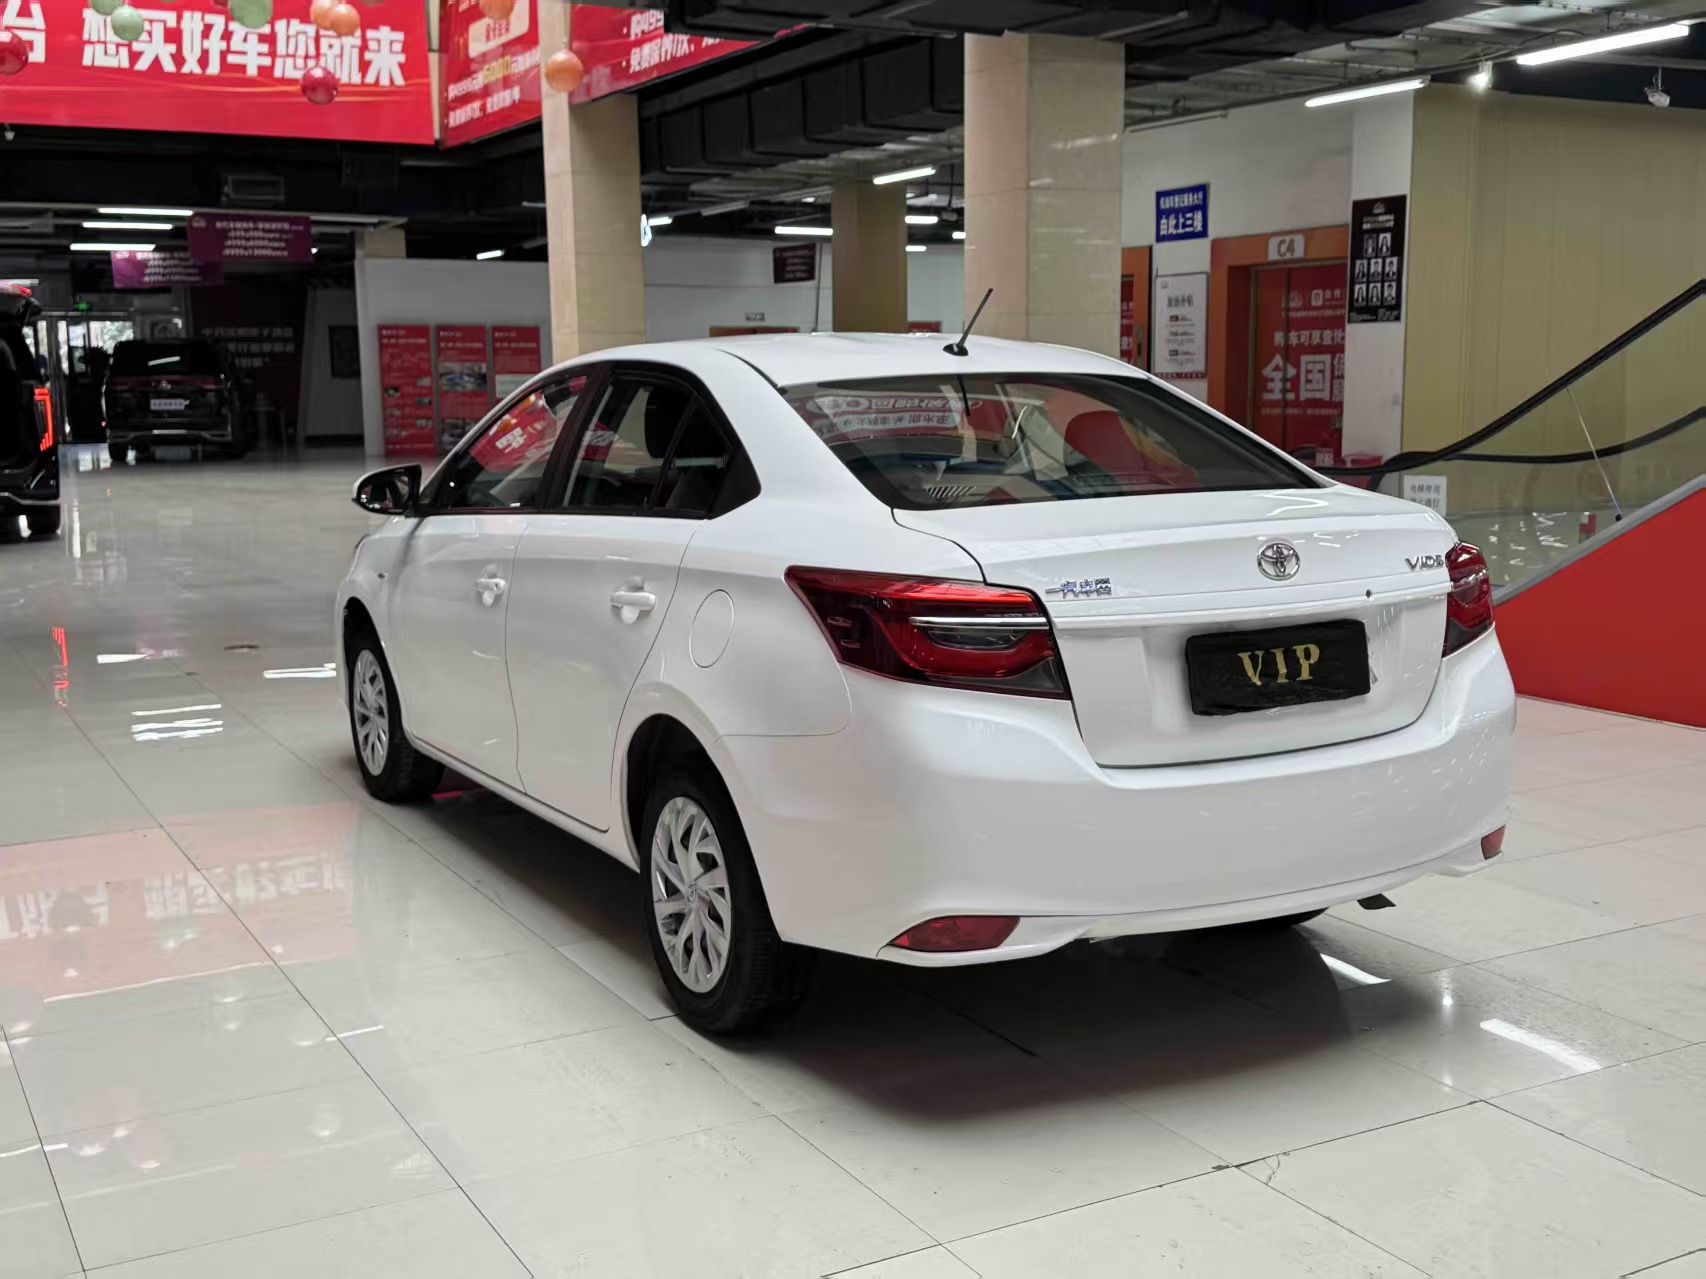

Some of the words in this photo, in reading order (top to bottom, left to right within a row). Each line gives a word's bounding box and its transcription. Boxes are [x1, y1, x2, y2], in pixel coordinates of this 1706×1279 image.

[82, 8, 407, 87] 想买好车您就来
[1160, 210, 1203, 236] 由此上三楼
[1277, 238, 1295, 257] C4
[1405, 555, 1444, 571] VIOS
[1238, 643, 1320, 687] VIP
